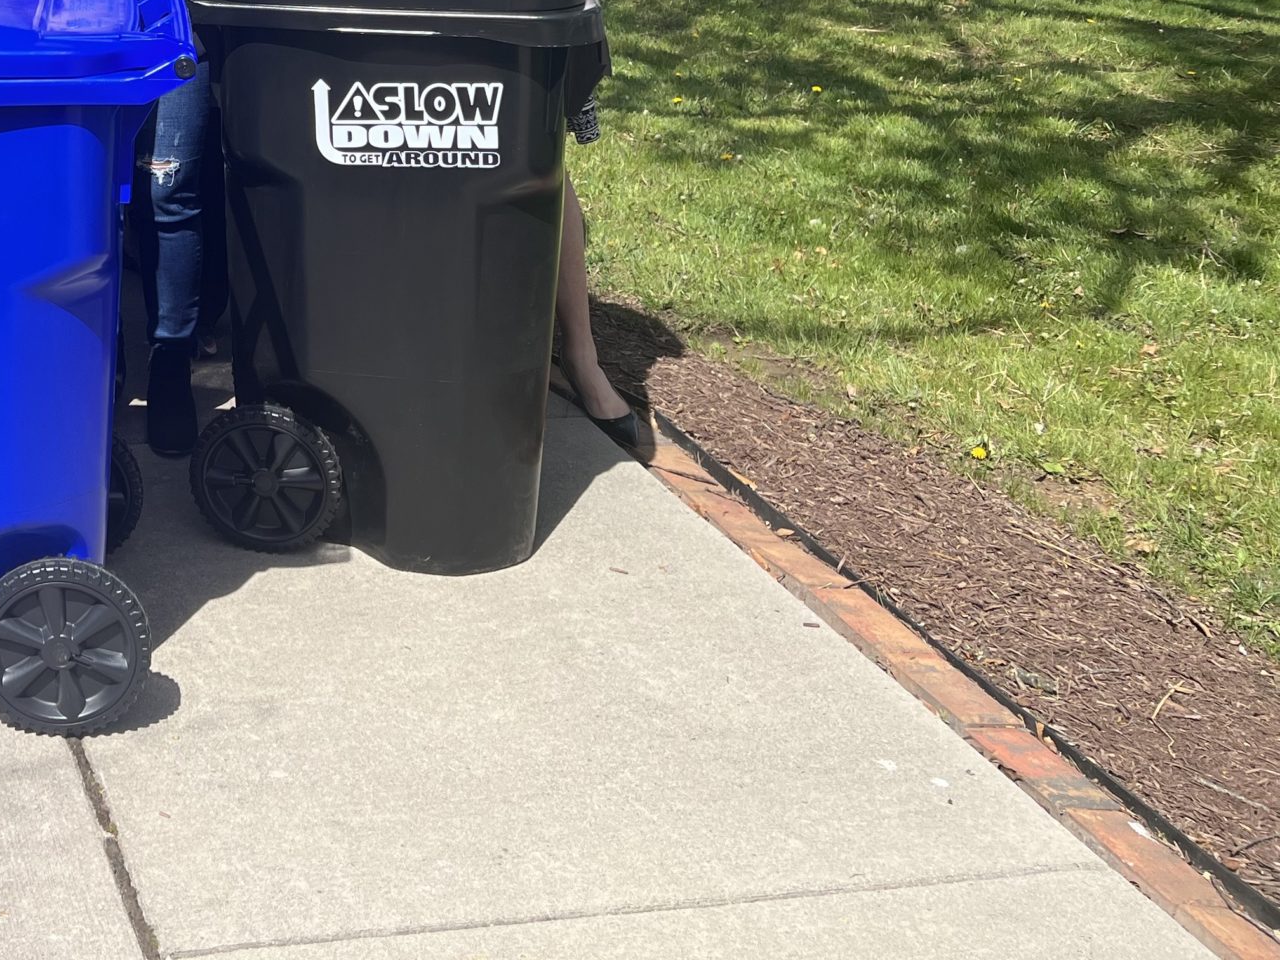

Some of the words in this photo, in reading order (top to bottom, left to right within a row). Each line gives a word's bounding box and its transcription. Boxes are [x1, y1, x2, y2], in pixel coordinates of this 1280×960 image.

[370, 83, 504, 125] SLOW
[332, 125, 499, 149] DOWN
[342, 153, 357, 163] TO
[359, 153, 381, 164] GET
[382, 151, 500, 168] AROUND
